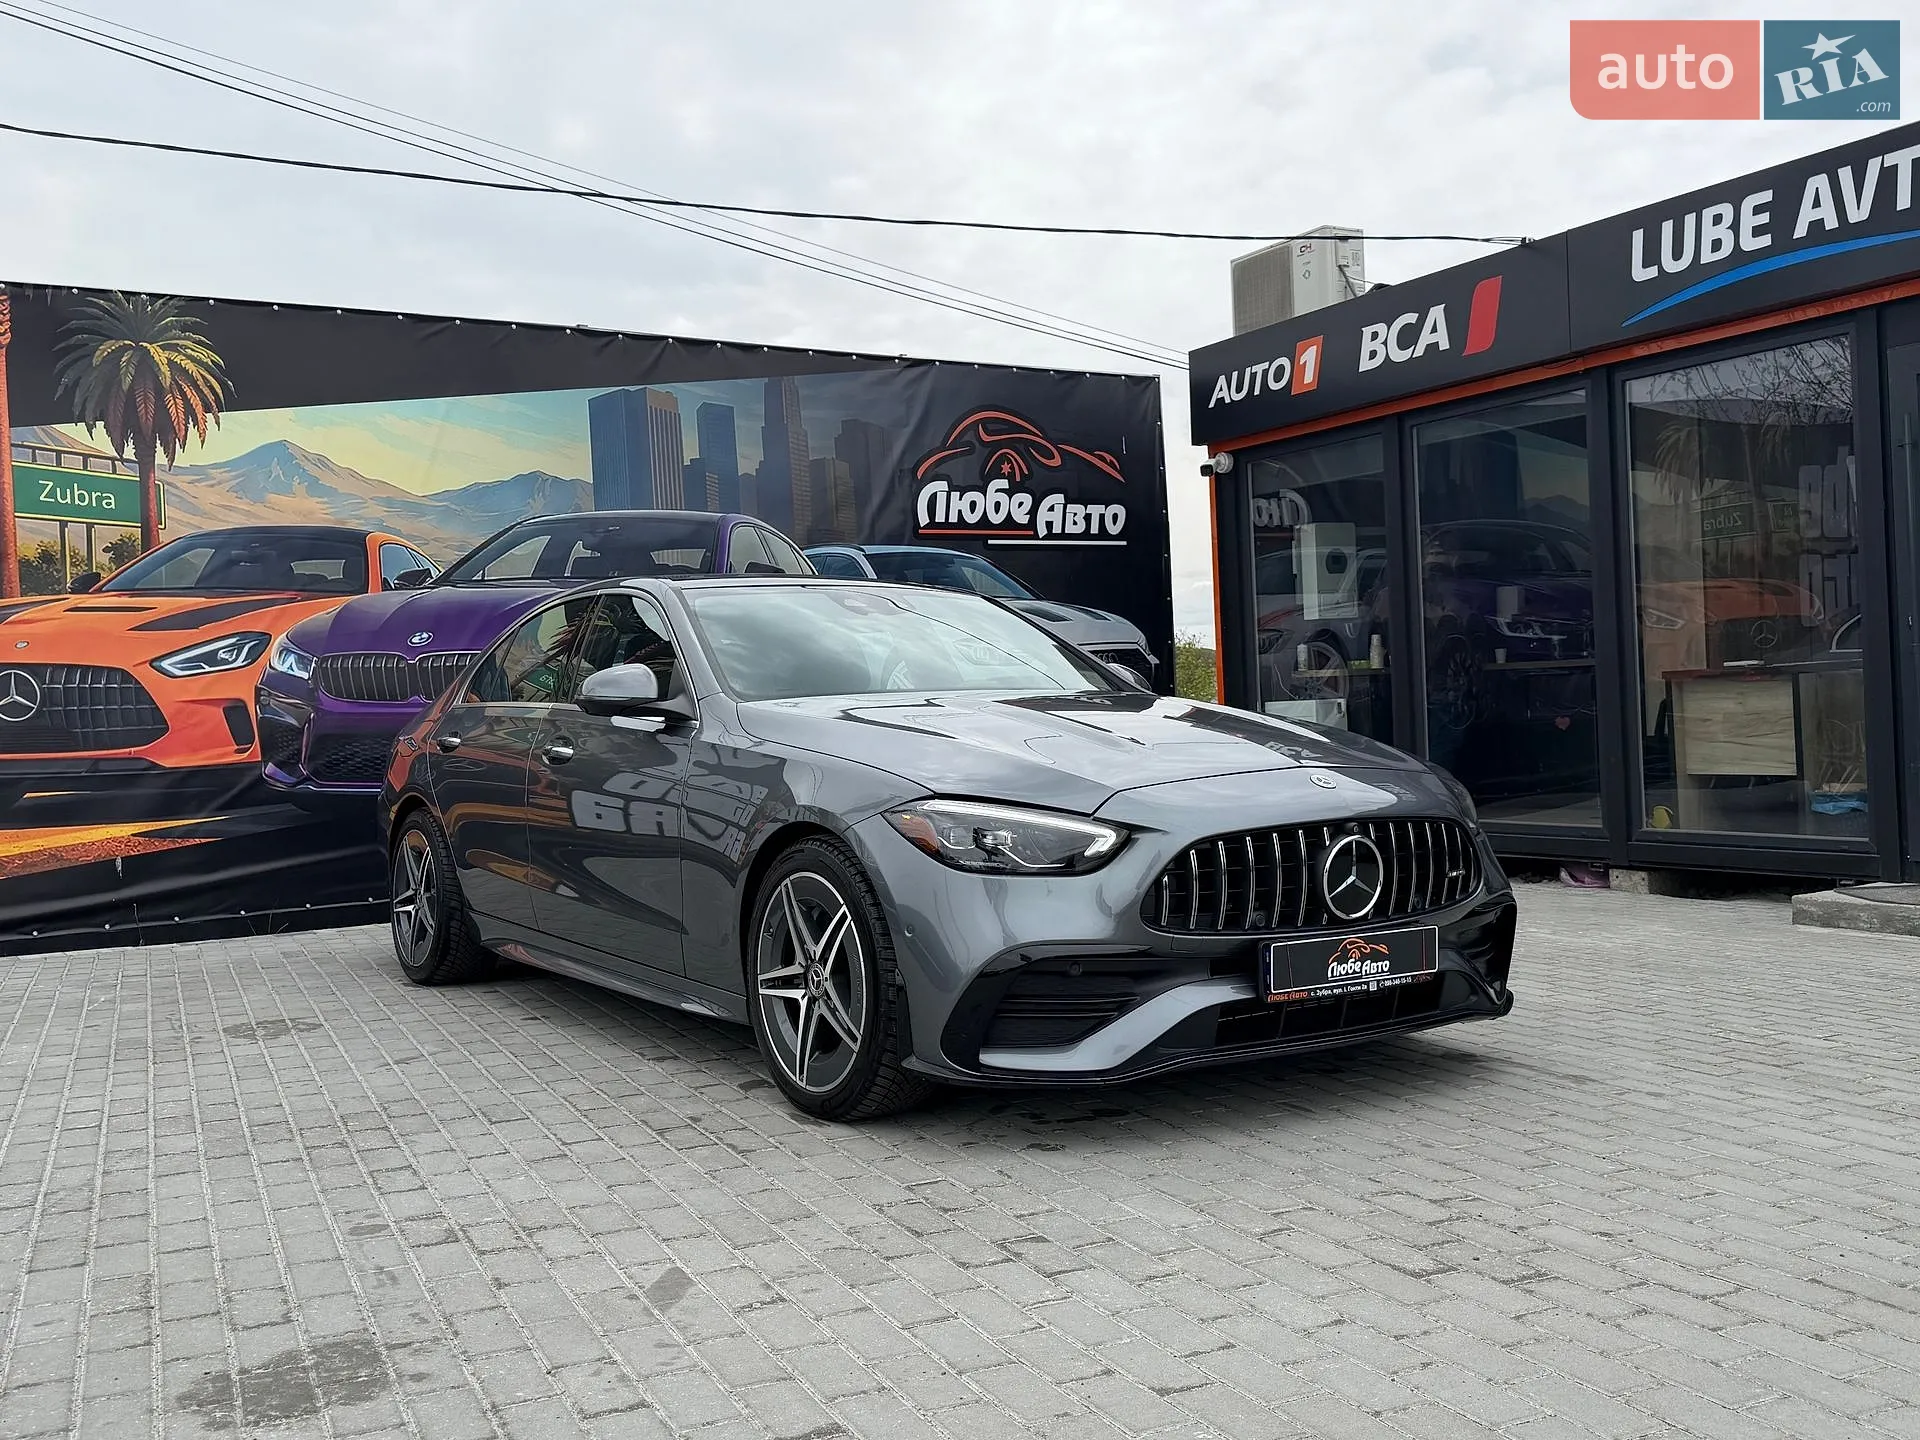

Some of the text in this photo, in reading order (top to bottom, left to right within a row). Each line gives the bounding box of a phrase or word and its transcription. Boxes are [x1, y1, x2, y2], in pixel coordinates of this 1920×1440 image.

[1630, 188, 1775, 283] LUBE
[1357, 302, 1451, 374] BCA
[38, 479, 116, 510] Zubra
[917, 478, 1127, 539] Любе Авто
